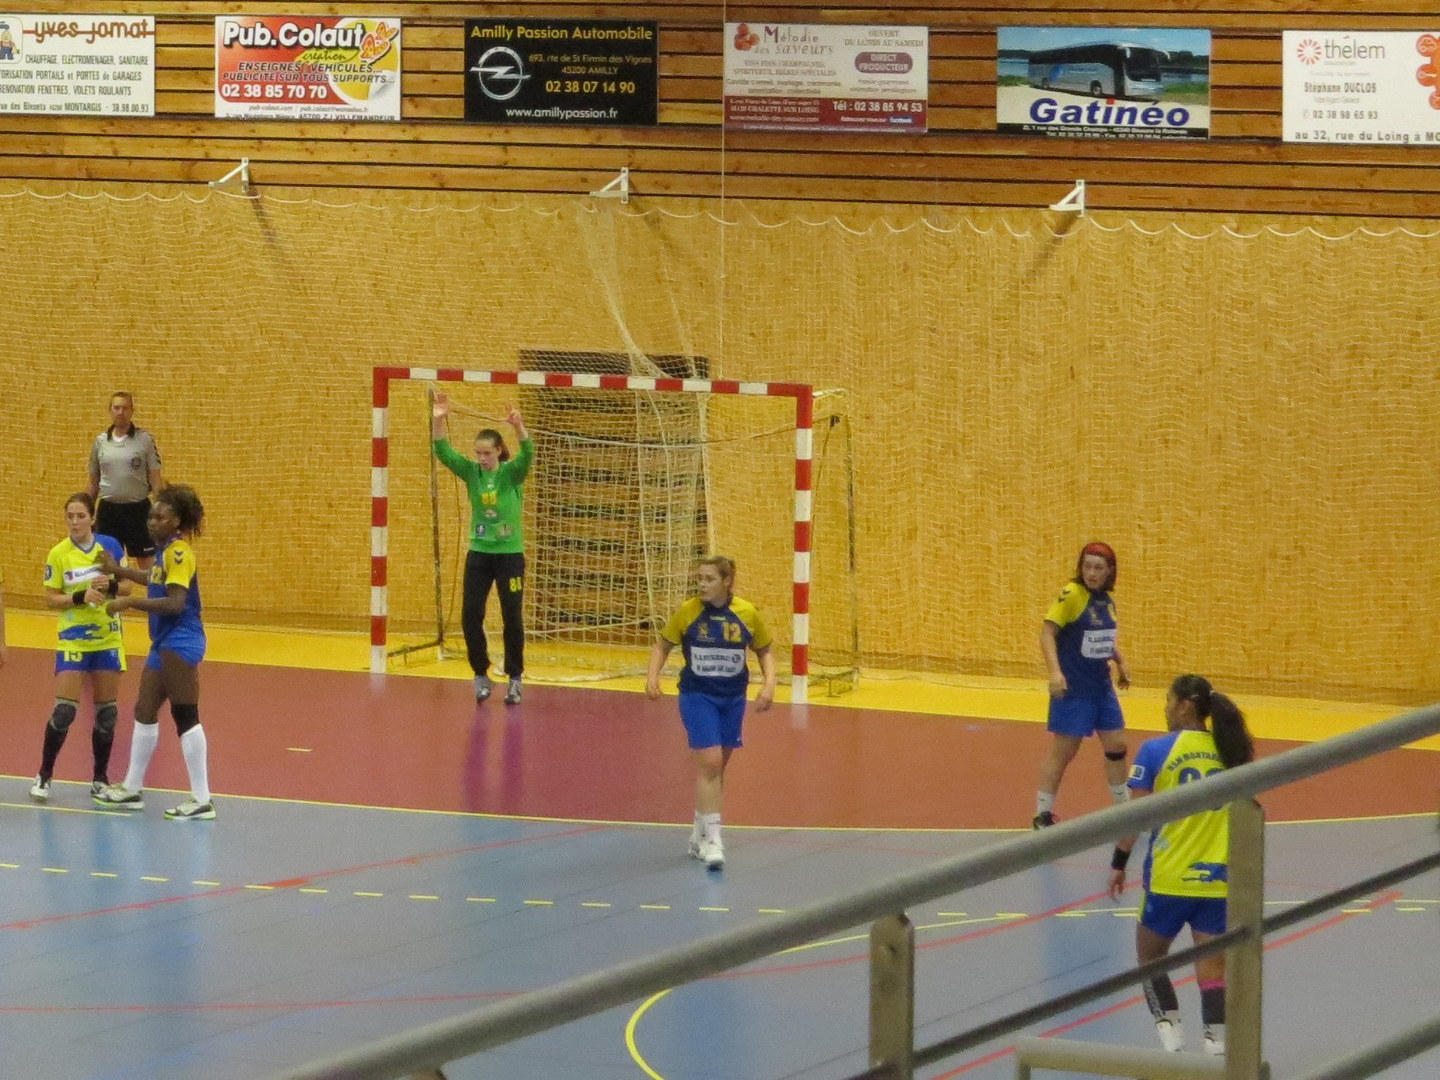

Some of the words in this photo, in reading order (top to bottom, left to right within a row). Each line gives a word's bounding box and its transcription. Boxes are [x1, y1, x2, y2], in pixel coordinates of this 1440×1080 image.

[35, 21, 79, 43] yves
[471, 25, 514, 41] Amilly
[517, 26, 568, 39] Passion
[572, 27, 653, 40] Automobile
[764, 26, 819, 43] Mélodie
[775, 45, 833, 55] saveurs
[1324, 35, 1385, 59] thélem
[118, 55, 149, 65] SANITAIRE
[547, 54, 559, 62] rte
[560, 54, 571, 63] de
[572, 54, 581, 63] St
[609, 55, 623, 63] des
[625, 55, 652, 65] Vignes
[859, 62, 909, 71] PRODUCTEUR
[35, 70, 65, 80] PORTAILS
[67, 72, 73, 80] et
[76, 70, 100, 81] PORTES
[102, 71, 110, 81] de
[112, 71, 142, 81] GARAGES
[223, 72, 275, 81] PUBLICITE
[278, 73, 300, 82] SUR
[303, 73, 329, 82] TOUS
[73, 85, 96, 95] VOLETS
[98, 86, 132, 96] ROULANTS
[222, 84, 240, 97] 02
[243, 84, 262, 98] 38
[265, 85, 284, 98] 85
[287, 85, 306, 98] 70
[308, 85, 327, 99] 70
[545, 80, 560, 93] 02
[564, 81, 579, 93] 38
[583, 81, 599, 93] 07
[602, 81, 616, 93] 14
[619, 82, 635, 94] 90
[1344, 82, 1377, 93] DUCLOS
[10, 101, 21, 110] des
[64, 102, 102, 112] MONTARGIS
[833, 101, 847, 111] Tél
[854, 101, 866, 111] 02
[868, 102, 880, 111] 38
[882, 102, 894, 112] 85
[896, 102, 909, 112] 94
[910, 102, 923, 112] 53
[1029, 97, 1190, 126] Gatinéo
[506, 106, 618, 120] www.amillypassion.fr
[1312, 110, 1323, 119] 02
[1326, 110, 1336, 119] 38
[1340, 110, 1350, 119] 98
[1354, 111, 1364, 119] 65
[1368, 111, 1378, 120] 93
[1295, 131, 1308, 139] au
[1313, 130, 1330, 141] 32,
[1335, 132, 1354, 140] rue
[1360, 131, 1373, 140] du
[1377, 131, 1409, 143] Loing
